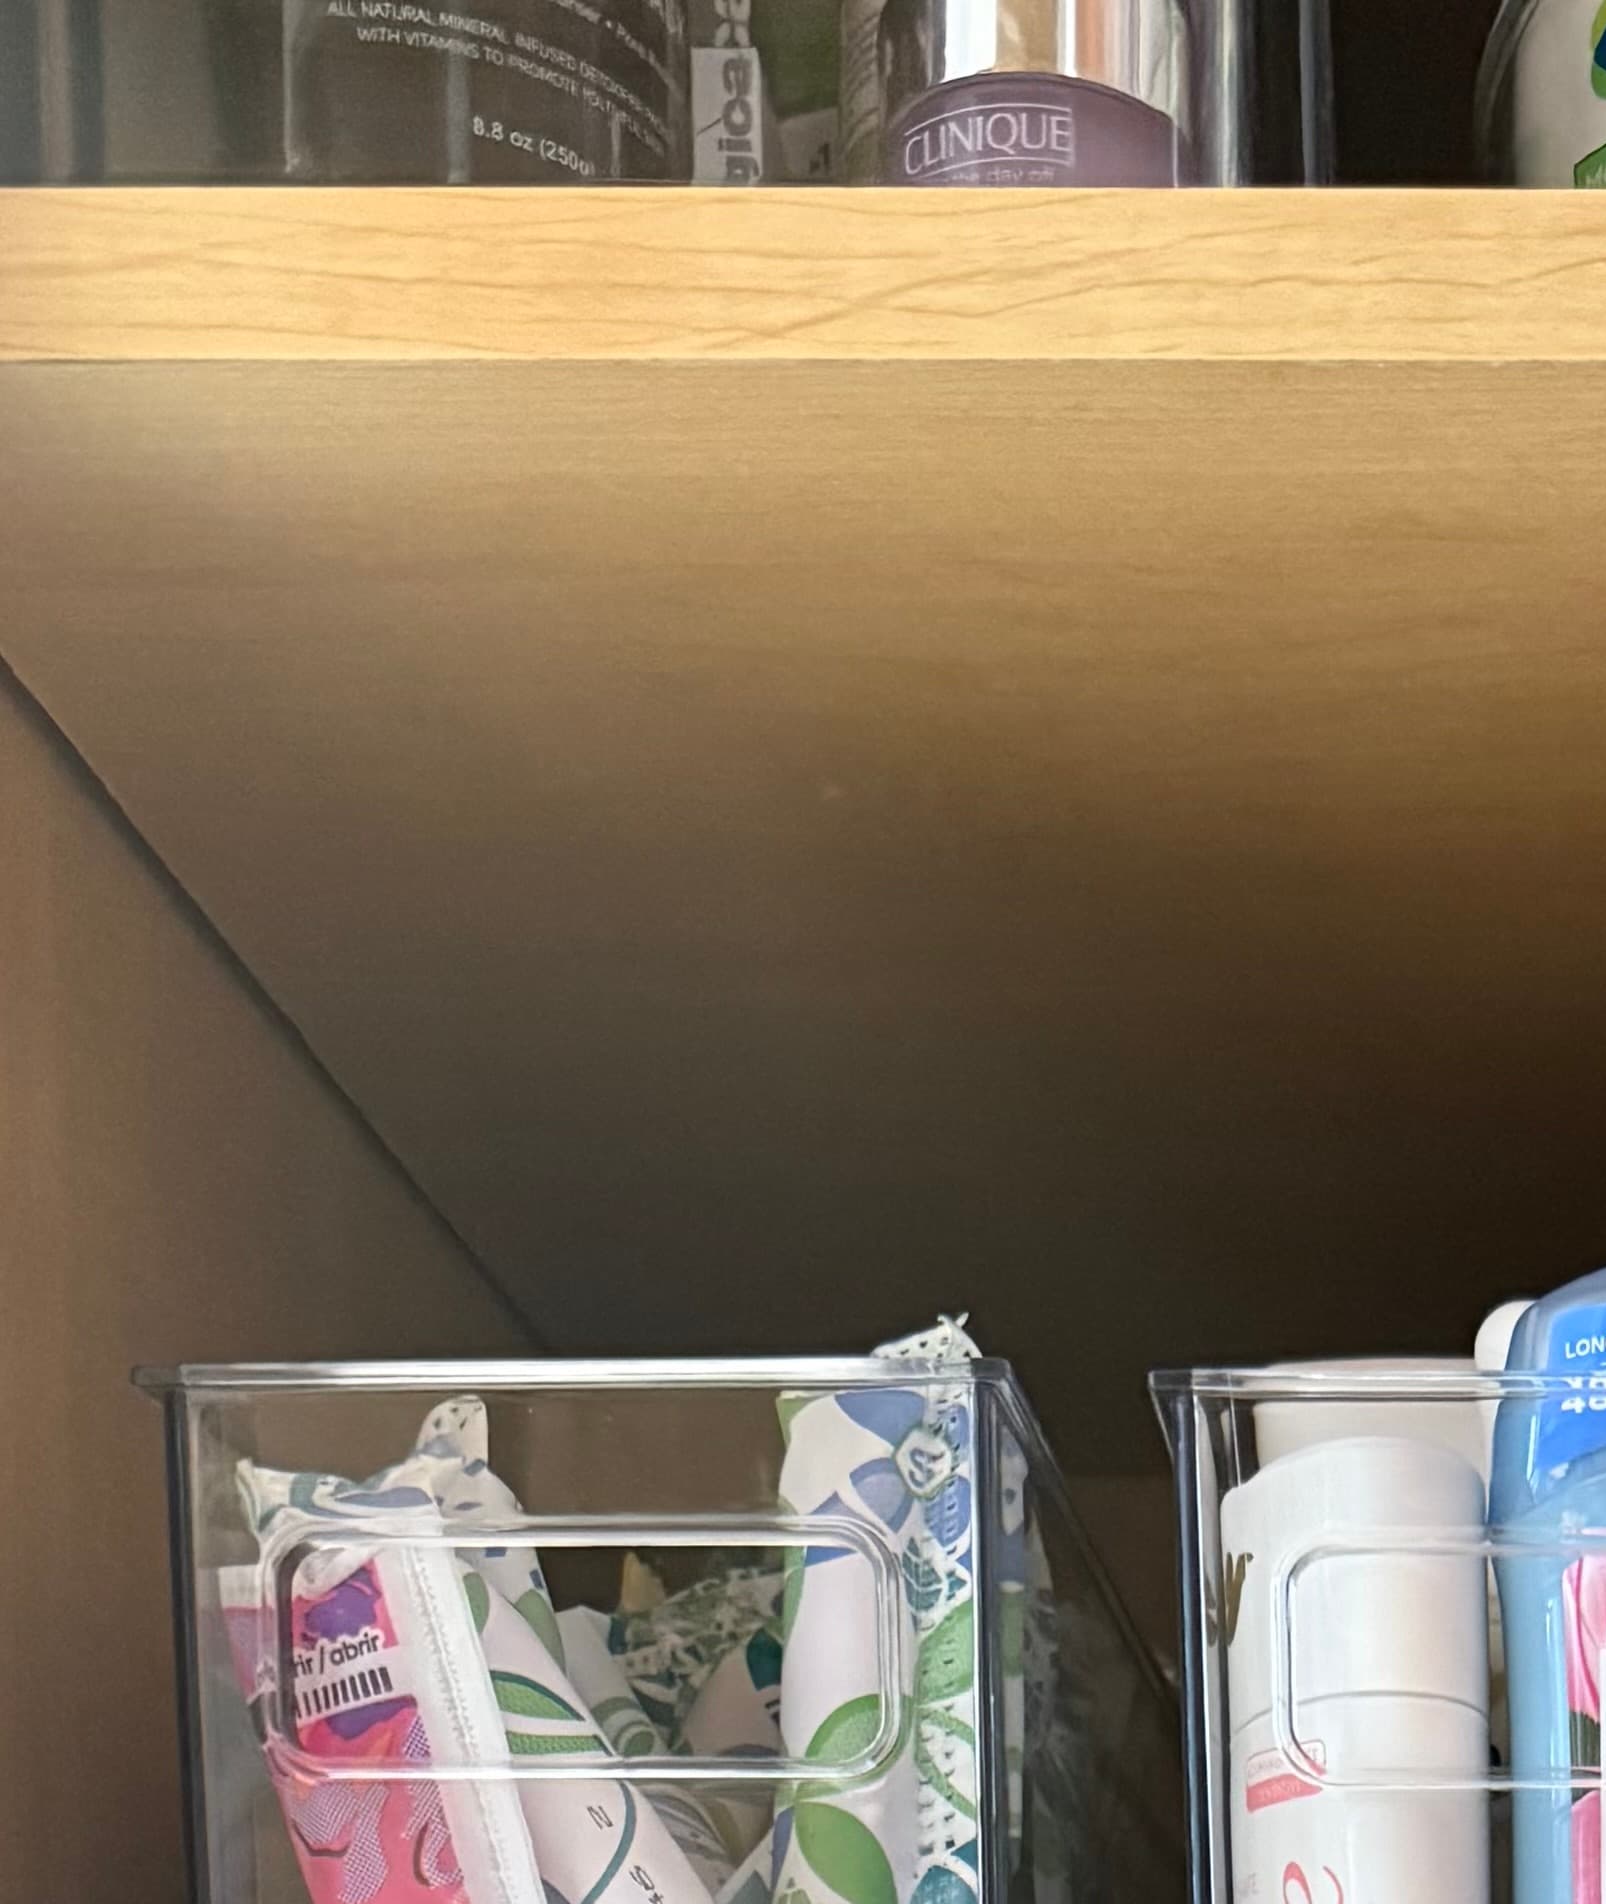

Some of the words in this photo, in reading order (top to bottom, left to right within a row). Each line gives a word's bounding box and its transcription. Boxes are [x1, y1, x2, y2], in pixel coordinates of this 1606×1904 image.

[356, 26, 400, 45] WITH
[510, 131, 533, 151] oz
[905, 113, 1073, 175] CLINIQUE
[330, 1632, 380, 1666] abrir
